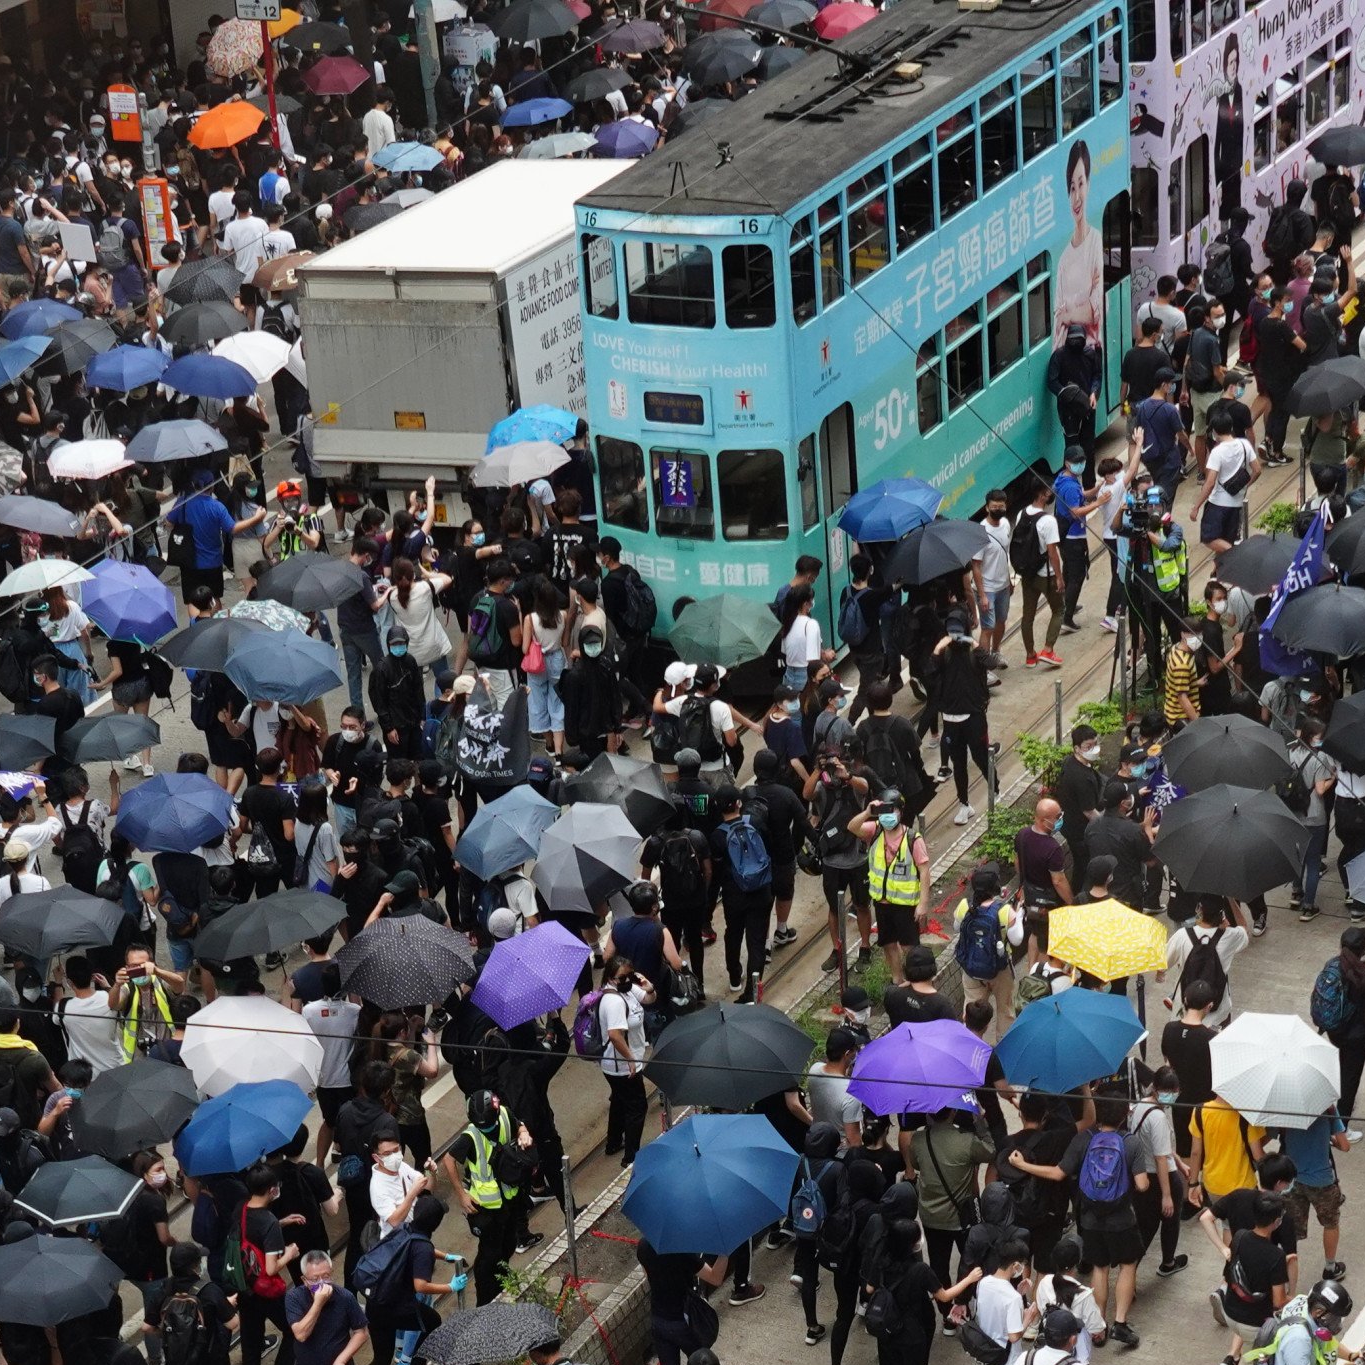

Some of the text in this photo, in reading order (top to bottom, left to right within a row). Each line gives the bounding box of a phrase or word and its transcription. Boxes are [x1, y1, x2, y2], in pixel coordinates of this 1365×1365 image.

[263, 6, 277, 17] 12
[1259, 10, 1285, 46] Hong
[584, 211, 597, 228] 16
[738, 218, 758, 234] 16
[906, 174, 1056, 329] 子宮頸癌篩查
[520, 258, 613, 325] ADVANCE FOOD COMP LIMITED
[562, 313, 582, 339] 3956
[592, 332, 624, 351] LOVE
[627, 341, 681, 359] Yourself
[611, 354, 768, 378] CHERISH Your Health!
[717, 422, 749, 430] Department
[756, 421, 774, 429] Health
[858, 387, 909, 450] Aged 50+
[926, 395, 1034, 490] ervical cancer screening
[492, 769, 514, 777] TIMES
